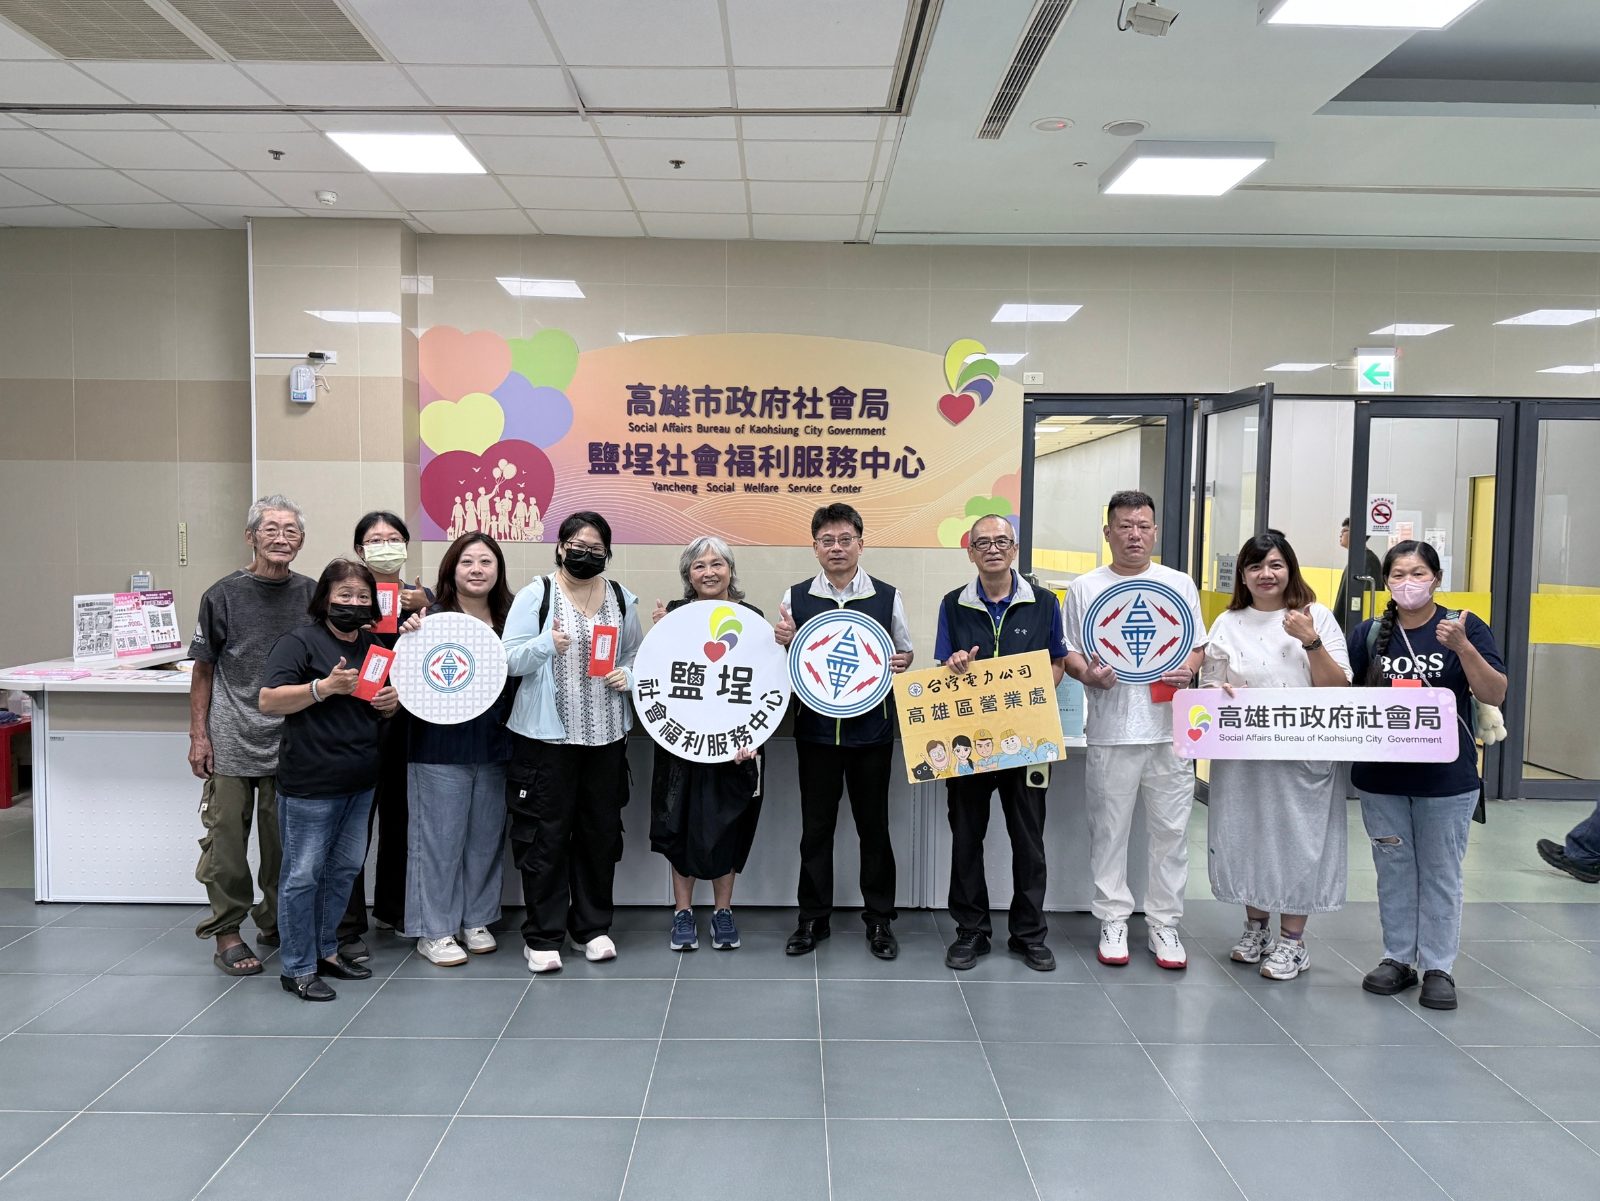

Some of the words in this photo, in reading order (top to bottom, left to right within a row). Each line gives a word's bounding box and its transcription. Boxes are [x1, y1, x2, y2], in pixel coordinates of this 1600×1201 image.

[625, 382, 889, 421] 高雄市政府社會局
[628, 422, 658, 433] Social
[662, 422, 692, 433] Affairs
[697, 424, 730, 434] Bureau
[735, 424, 746, 434] of
[750, 425, 799, 437] Kaohsiung
[804, 426, 823, 438] City
[828, 426, 887, 436] Government
[587, 441, 926, 479] 鹽埕社會福利服務中心
[652, 482, 698, 494] Yancheng
[706, 483, 735, 493] Social
[743, 483, 779, 493] Welfare
[788, 484, 823, 493] Service
[831, 484, 862, 494] Center
[668, 661, 753, 705] 鹽埕
[927, 664, 1033, 693] 台灣電力公司
[638, 678, 784, 757] 社會福利服務中心
[906, 687, 1047, 726] 高雄區營業處
[1217, 704, 1443, 731] 高雄市政府社會局
[1219, 733, 1244, 743] Social
[1245, 733, 1272, 743] Affairs
[1274, 734, 1305, 743] Bureau
[1307, 734, 1316, 743] of
[1317, 734, 1363, 745] Kaohsiung
[1365, 734, 1383, 745] City
[1387, 734, 1443, 744] Government
